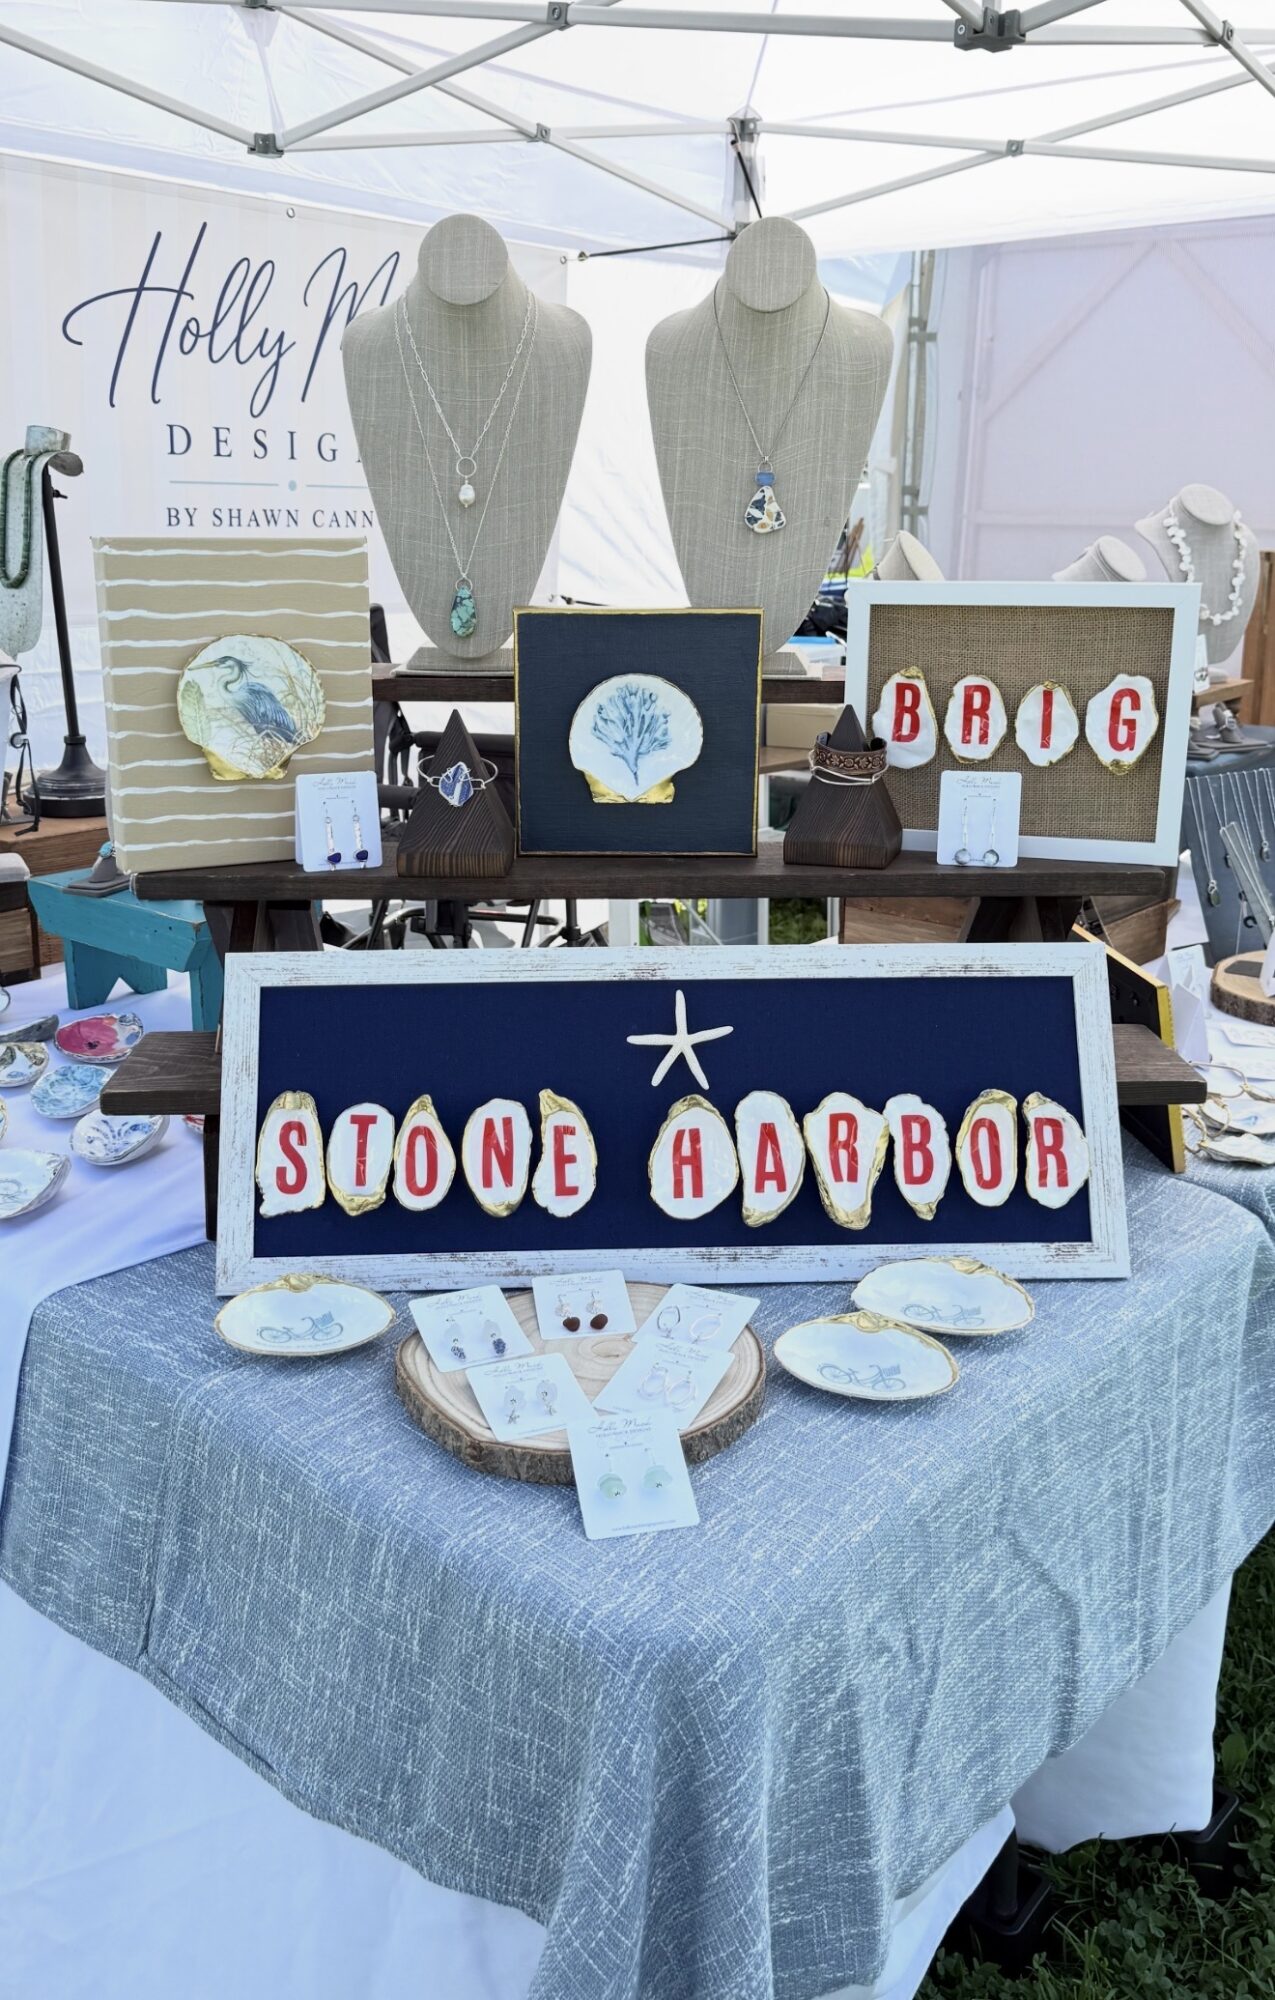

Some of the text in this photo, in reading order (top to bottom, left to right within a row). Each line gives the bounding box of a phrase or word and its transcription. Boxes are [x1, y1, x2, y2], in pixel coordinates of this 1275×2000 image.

[62, 221, 296, 418] Holly
[166, 424, 363, 463] DESIG
[166, 507, 197, 527] BY
[212, 507, 300, 528] SHAWN
[891, 682, 1141, 752] BRIG
[275, 1112, 1069, 1199] STONE HARBOR
